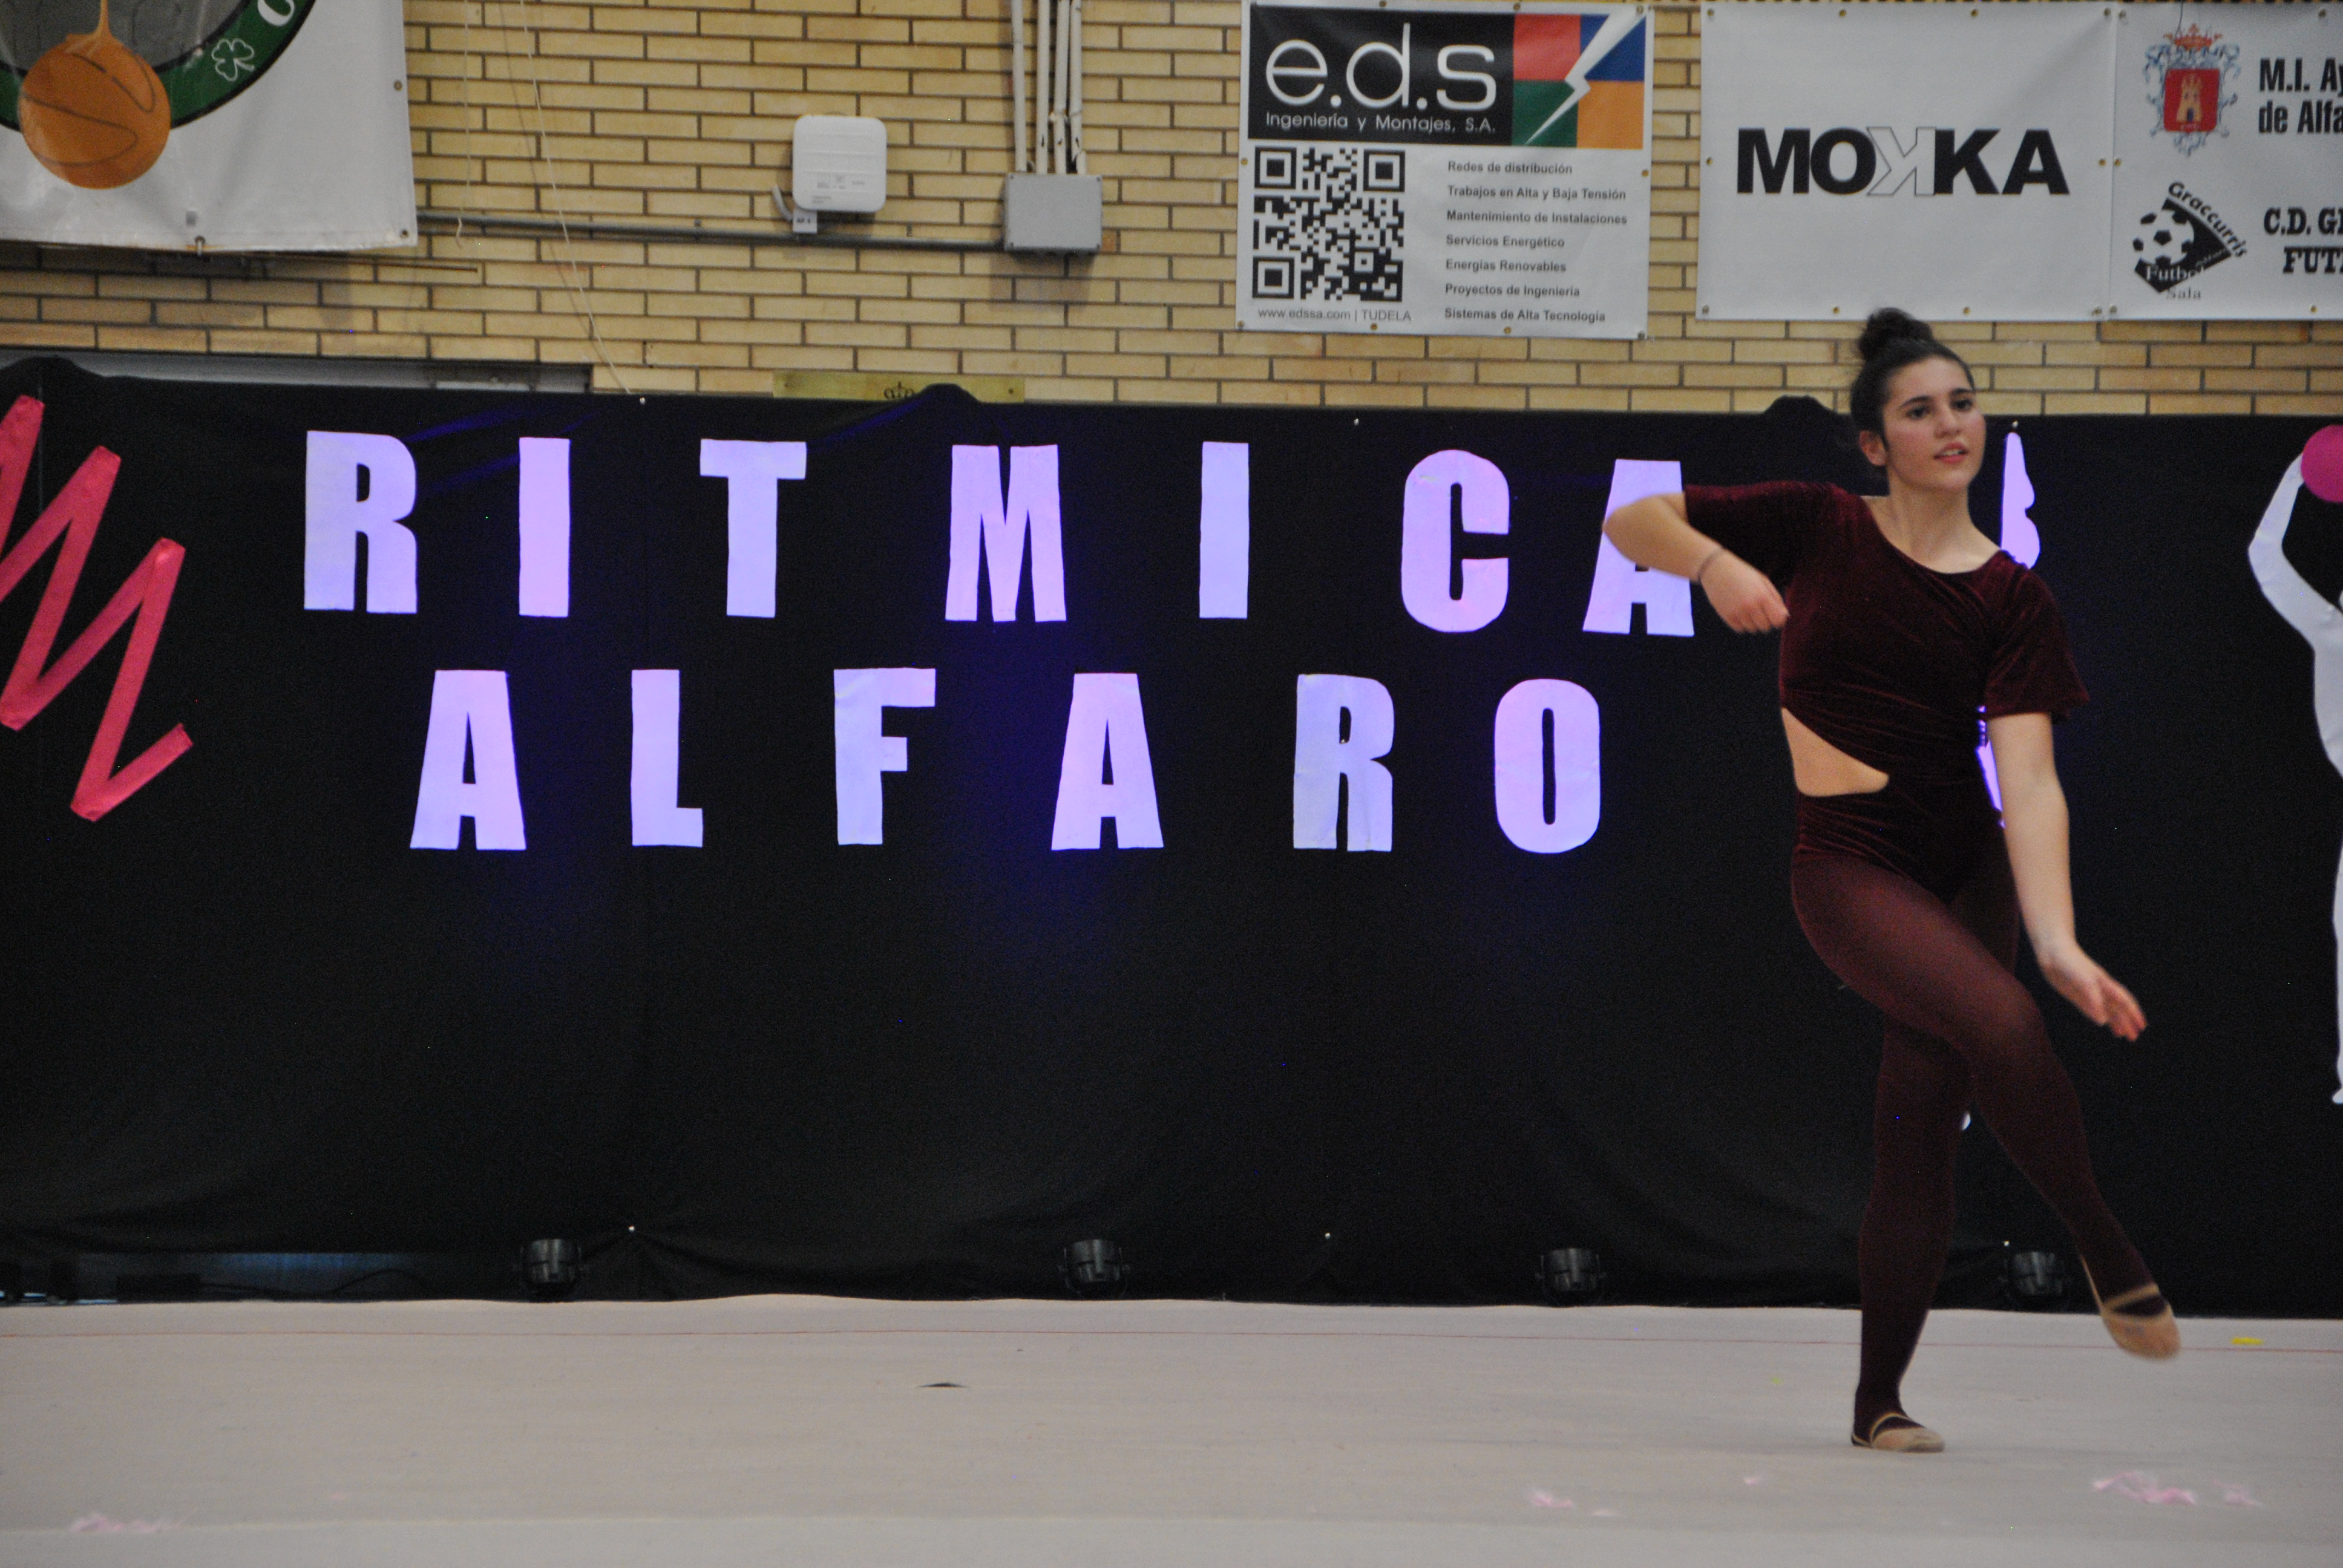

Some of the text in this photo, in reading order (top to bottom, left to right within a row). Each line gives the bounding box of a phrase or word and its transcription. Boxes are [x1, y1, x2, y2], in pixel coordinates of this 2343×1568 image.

[1265, 22, 1496, 111] e.d.s
[2259, 57, 2310, 92] M.I.
[1267, 111, 1348, 131] Ingeniería
[1357, 116, 1367, 133] y
[1465, 117, 1496, 132] S.A.
[2259, 99, 2289, 134] de
[1447, 160, 1573, 175] Redes de distribución
[1447, 185, 1627, 201] Trabajos en Alta y Baja Tensión
[1446, 209, 1628, 224] Mantenimiento de Instalaciones
[2168, 181, 2247, 258] Graccurris
[2264, 206, 2312, 235] C.D.
[1446, 234, 1565, 249] Servicios Energético
[1446, 258, 1567, 273] Energías Renovables
[2282, 246, 2343, 274] FUT
[1445, 283, 1580, 298] Proyectos de Ingeniería
[1257, 308, 1351, 320] www.edssa.com
[1362, 309, 1412, 322] TUDELA
[1444, 307, 1606, 324] Sistemas de Alta Tecnología
[304, 430, 1694, 636] RITMICA
[410, 667, 1601, 853] ALFARO
